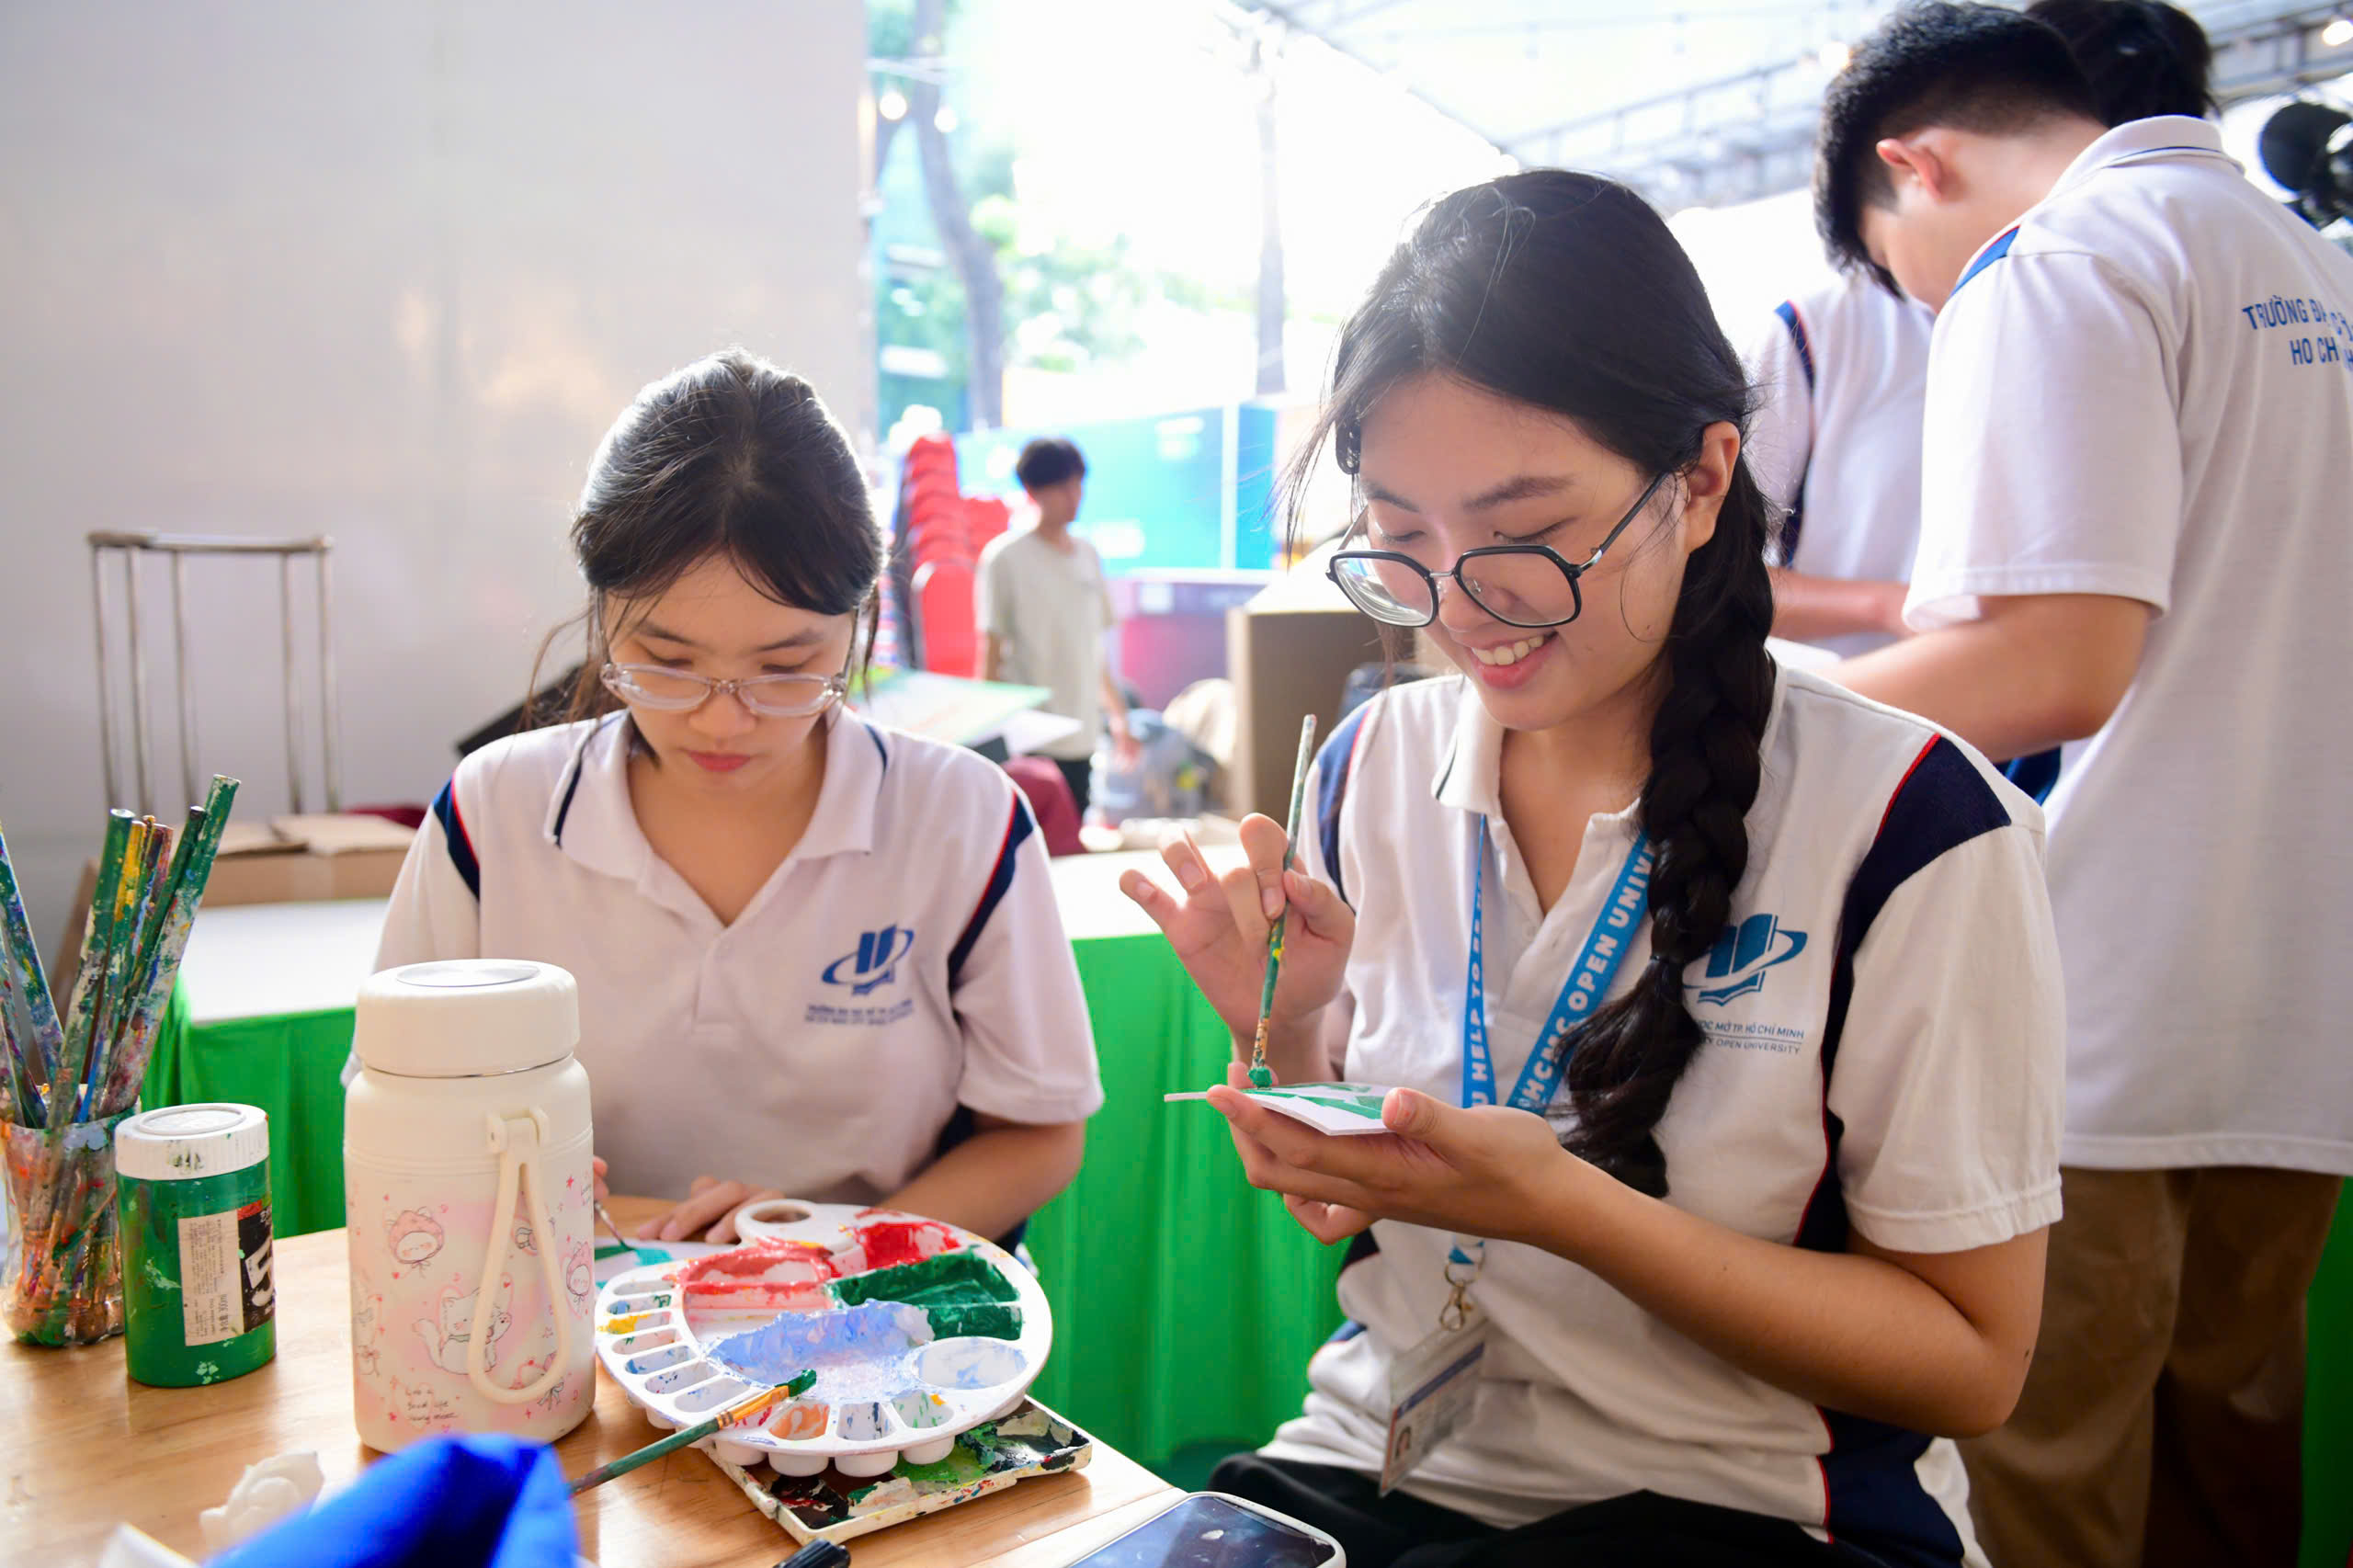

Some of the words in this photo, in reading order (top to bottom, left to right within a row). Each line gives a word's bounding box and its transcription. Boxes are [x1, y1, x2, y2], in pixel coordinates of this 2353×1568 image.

[1471, 962, 1481, 999] TO
[1567, 933, 1619, 1011] OPEN
[1470, 1008, 1488, 1082] HELP
[1716, 1038, 1743, 1050] OPEN
[1743, 1040, 1802, 1055] UNIVERSITY
[1776, 1026, 1805, 1039] MINH
